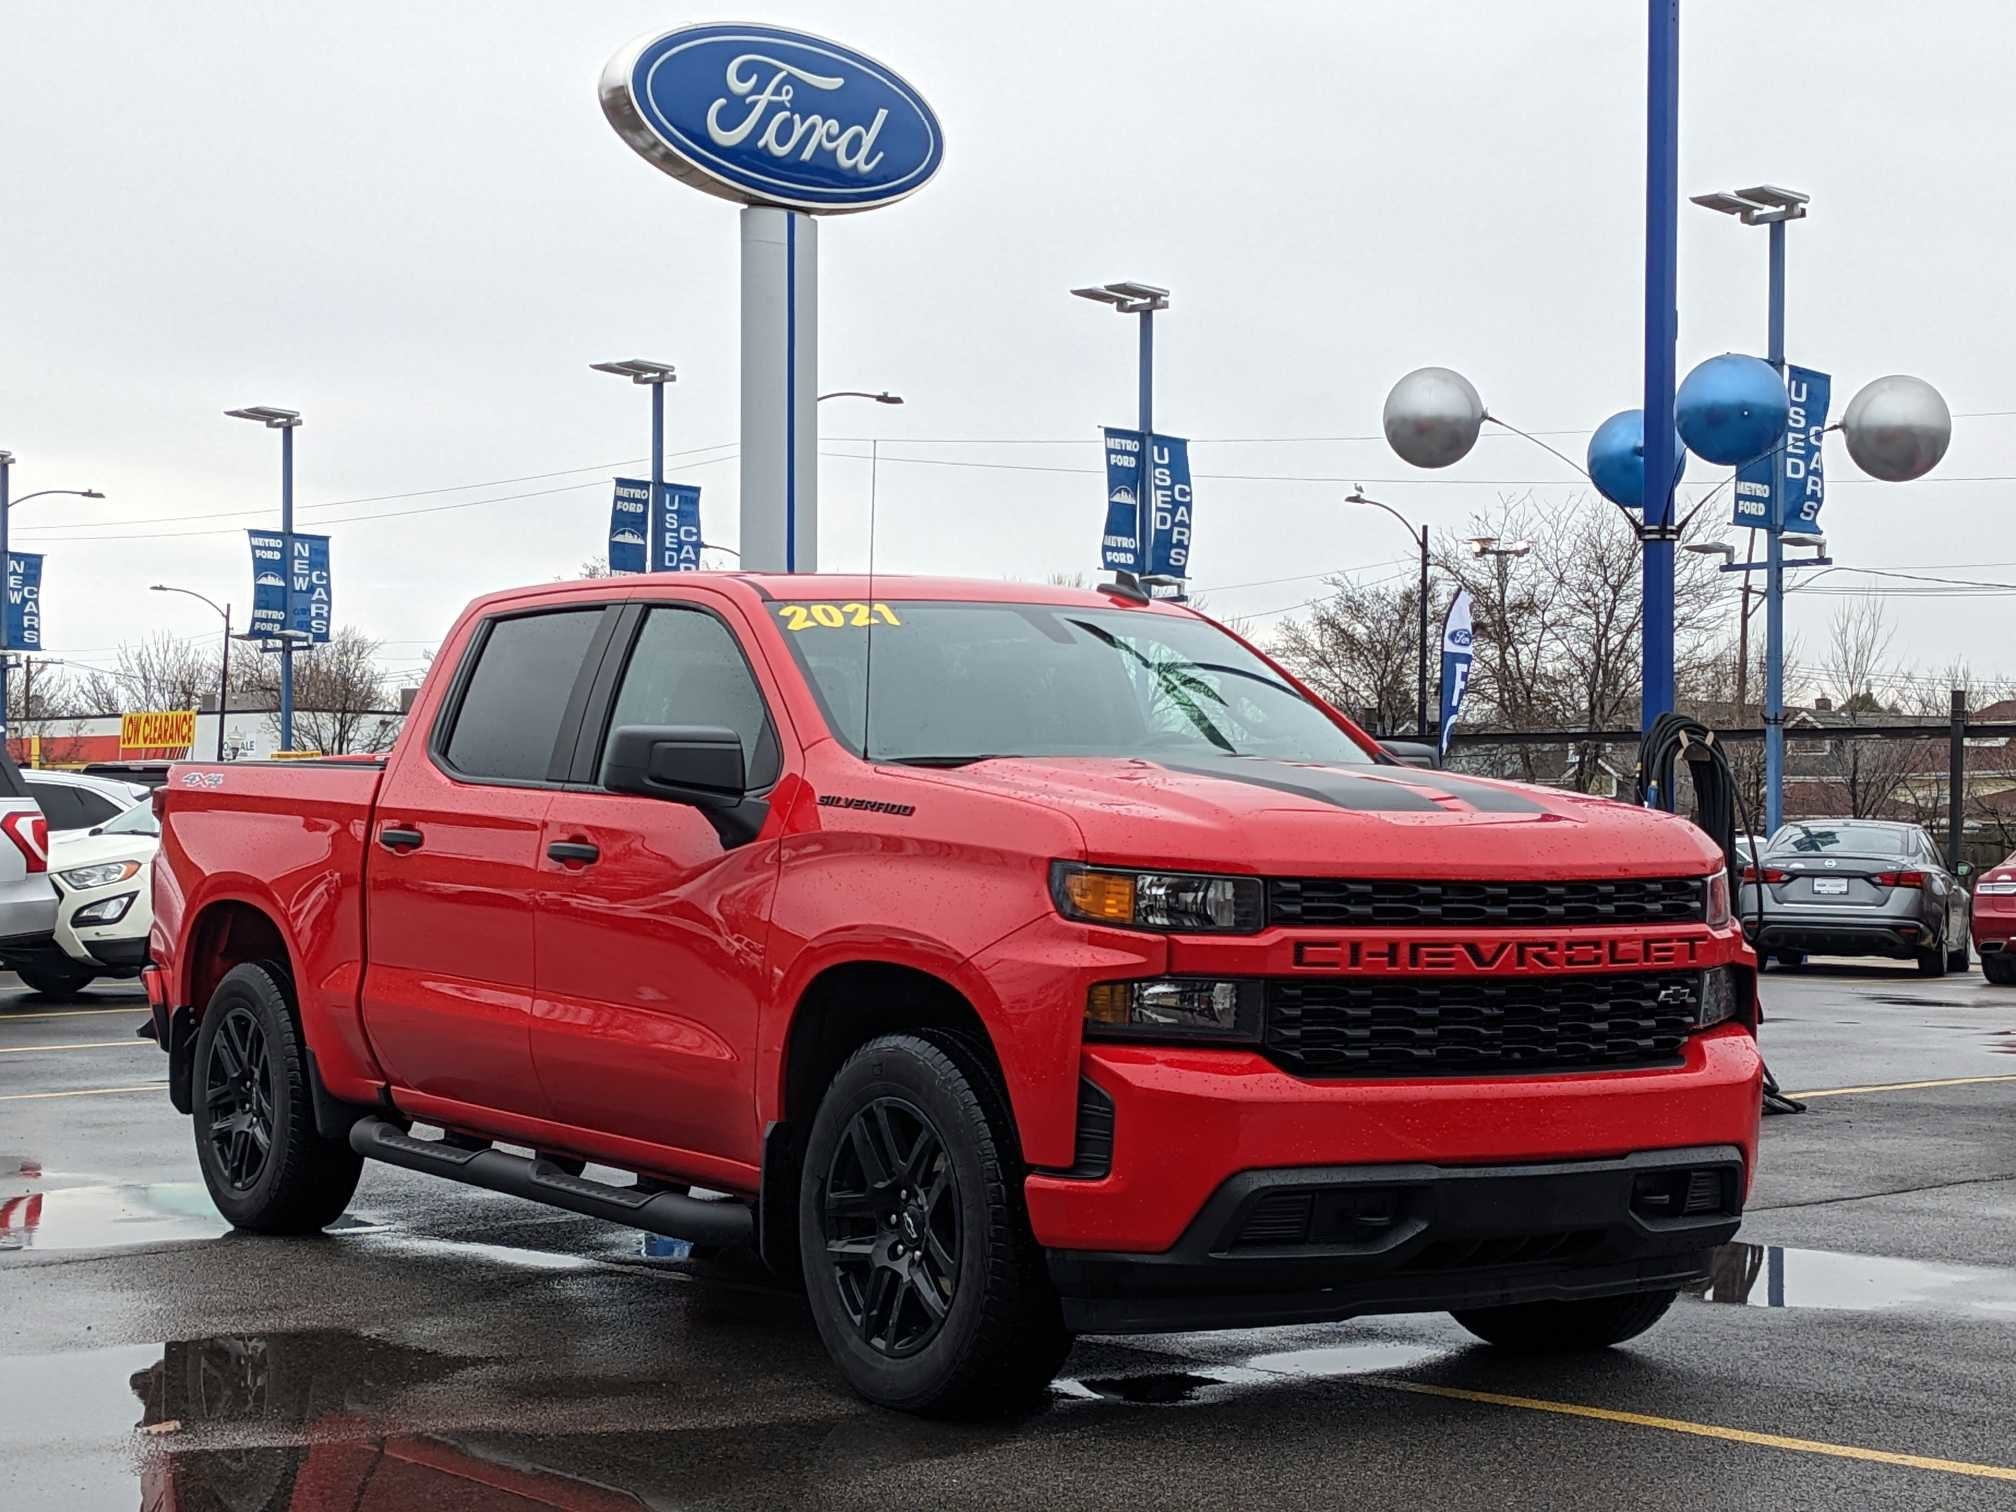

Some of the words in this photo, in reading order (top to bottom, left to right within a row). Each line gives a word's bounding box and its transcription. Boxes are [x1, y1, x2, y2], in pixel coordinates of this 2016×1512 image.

[706, 54, 889, 175] Ford
[1105, 437, 1140, 452] METRO
[1785, 380, 1807, 479] USED
[1799, 426, 1824, 521] CARS
[1110, 454, 1136, 468] FORD
[615, 486, 649, 500] METRO
[1736, 481, 1770, 498] METRO
[616, 501, 644, 513] FORD
[1152, 445, 1172, 530] USED
[1168, 484, 1191, 567] CARS
[1738, 500, 1766, 516] FORD
[664, 493, 679, 567] USED
[250, 537, 283, 548] METRO
[1103, 534, 1136, 549] METRO
[255, 549, 281, 560] FORD
[1106, 551, 1135, 565] FORD
[293, 542, 310, 591] NEW
[310, 571, 329, 633] CARS
[9, 560, 25, 604] NEW
[23, 586, 39, 643] CARS
[253, 609, 286, 620] METRO
[778, 603, 901, 631] 2021
[253, 621, 281, 632] FORD
[121, 715, 142, 745] LOW
[142, 713, 193, 744] CLEARANCE
[817, 795, 916, 817] SILVERADO
[1292, 935, 1709, 971] CHEVROLET
